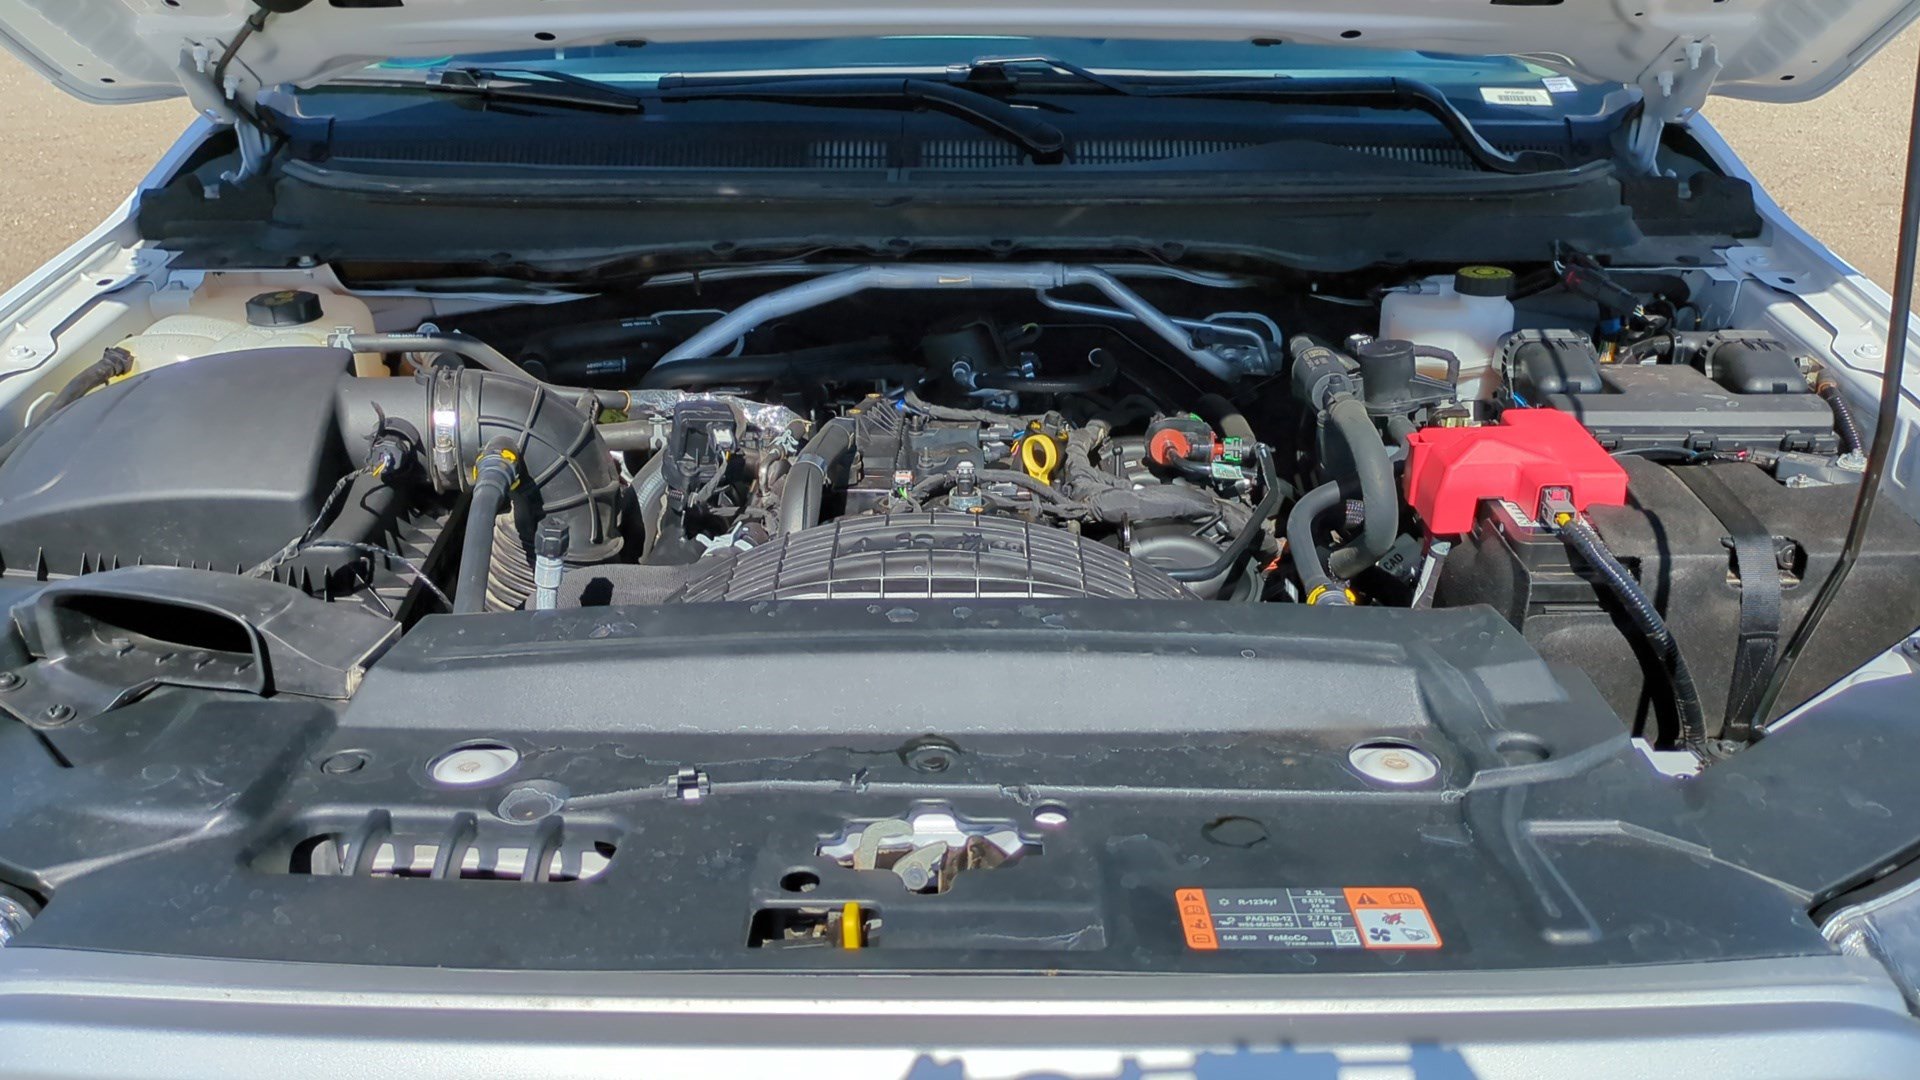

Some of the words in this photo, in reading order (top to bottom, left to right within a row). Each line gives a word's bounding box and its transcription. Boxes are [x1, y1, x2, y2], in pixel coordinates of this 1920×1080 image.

[1383, 553, 1404, 571] CAD
[1238, 898, 1277, 907] R-1234yf
[1245, 915, 1265, 923] PAG
[1266, 915, 1293, 923] ND-12
[1268, 934, 1309, 942] FoMoCo
